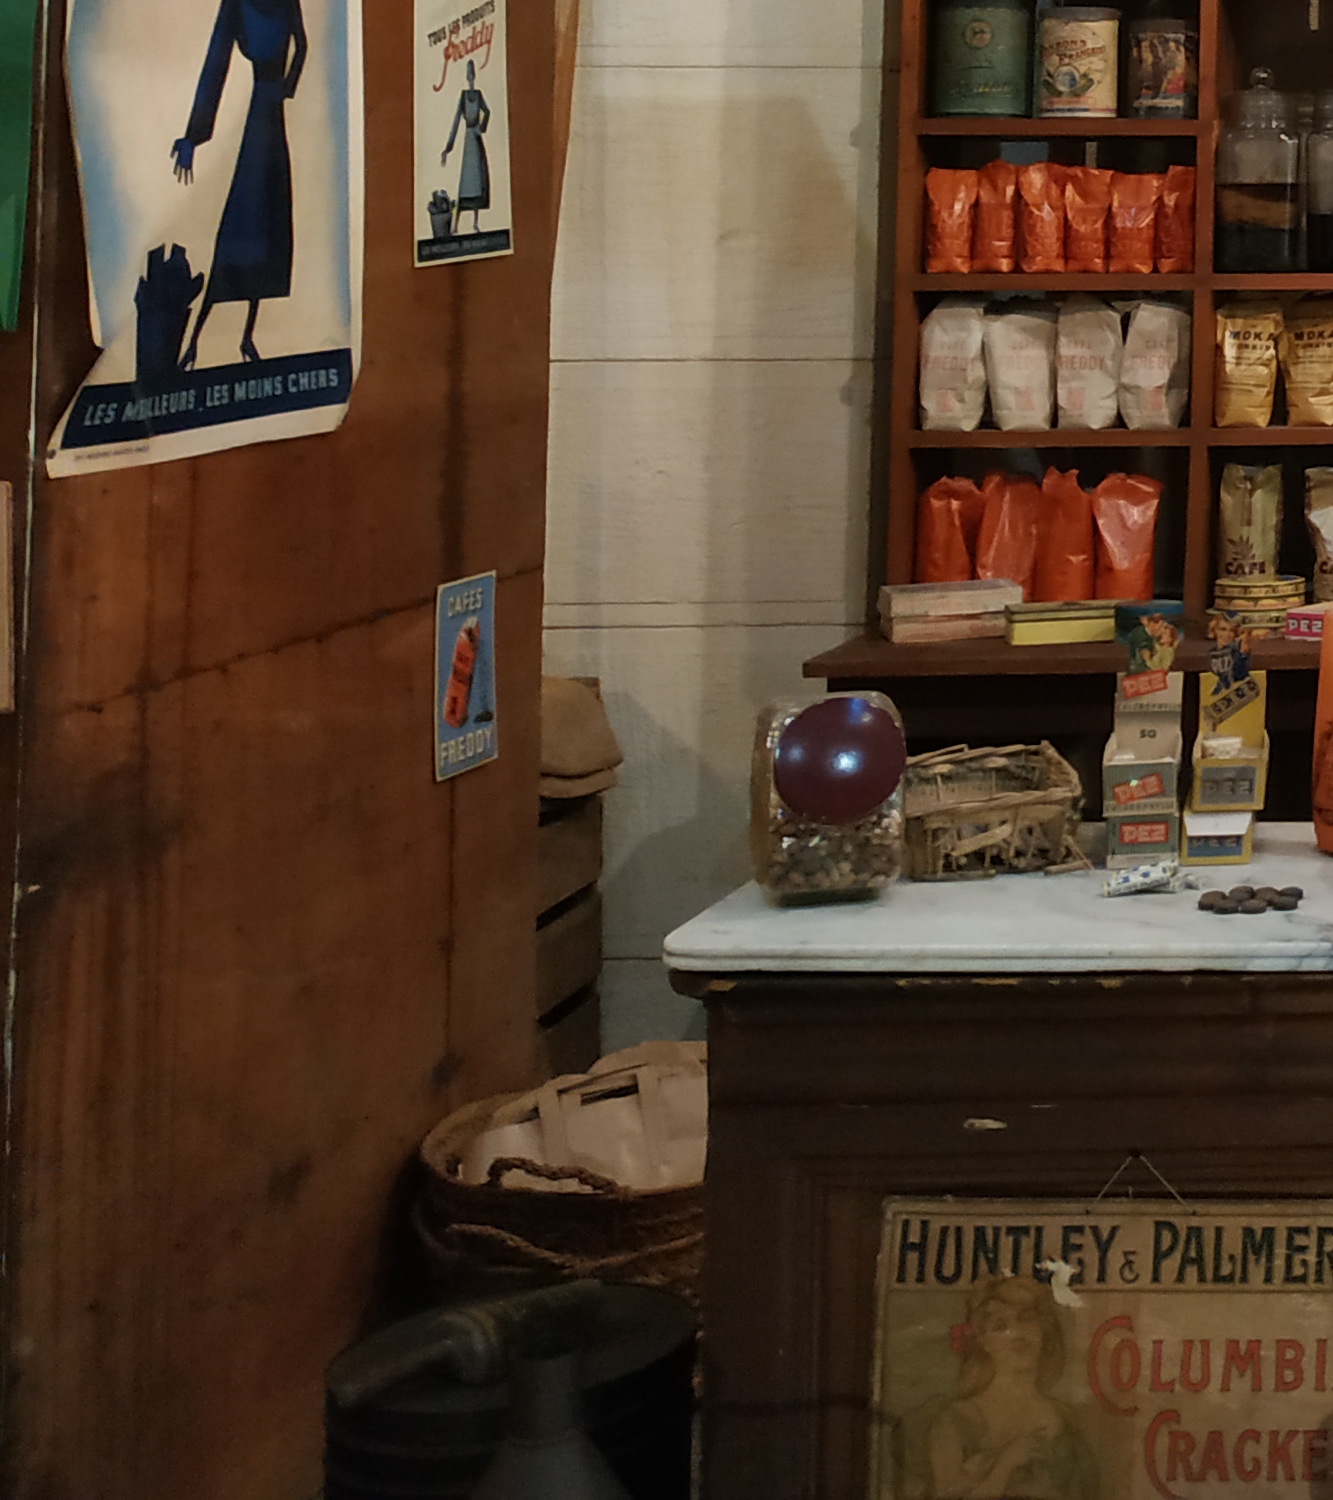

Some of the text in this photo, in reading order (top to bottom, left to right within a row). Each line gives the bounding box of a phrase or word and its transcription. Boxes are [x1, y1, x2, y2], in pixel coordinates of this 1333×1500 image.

[1229, 330, 1278, 342] MOKA
[83, 401, 119, 427] LES
[204, 382, 231, 409] LES
[233, 377, 284, 403] MOINS
[286, 367, 340, 394] CHERS
[1287, 617, 1323, 633] PEZ
[438, 725, 493, 768] FREDDY
[1123, 826, 1167, 842] PEZ
[895, 1218, 1121, 1285] HUNTLEY
